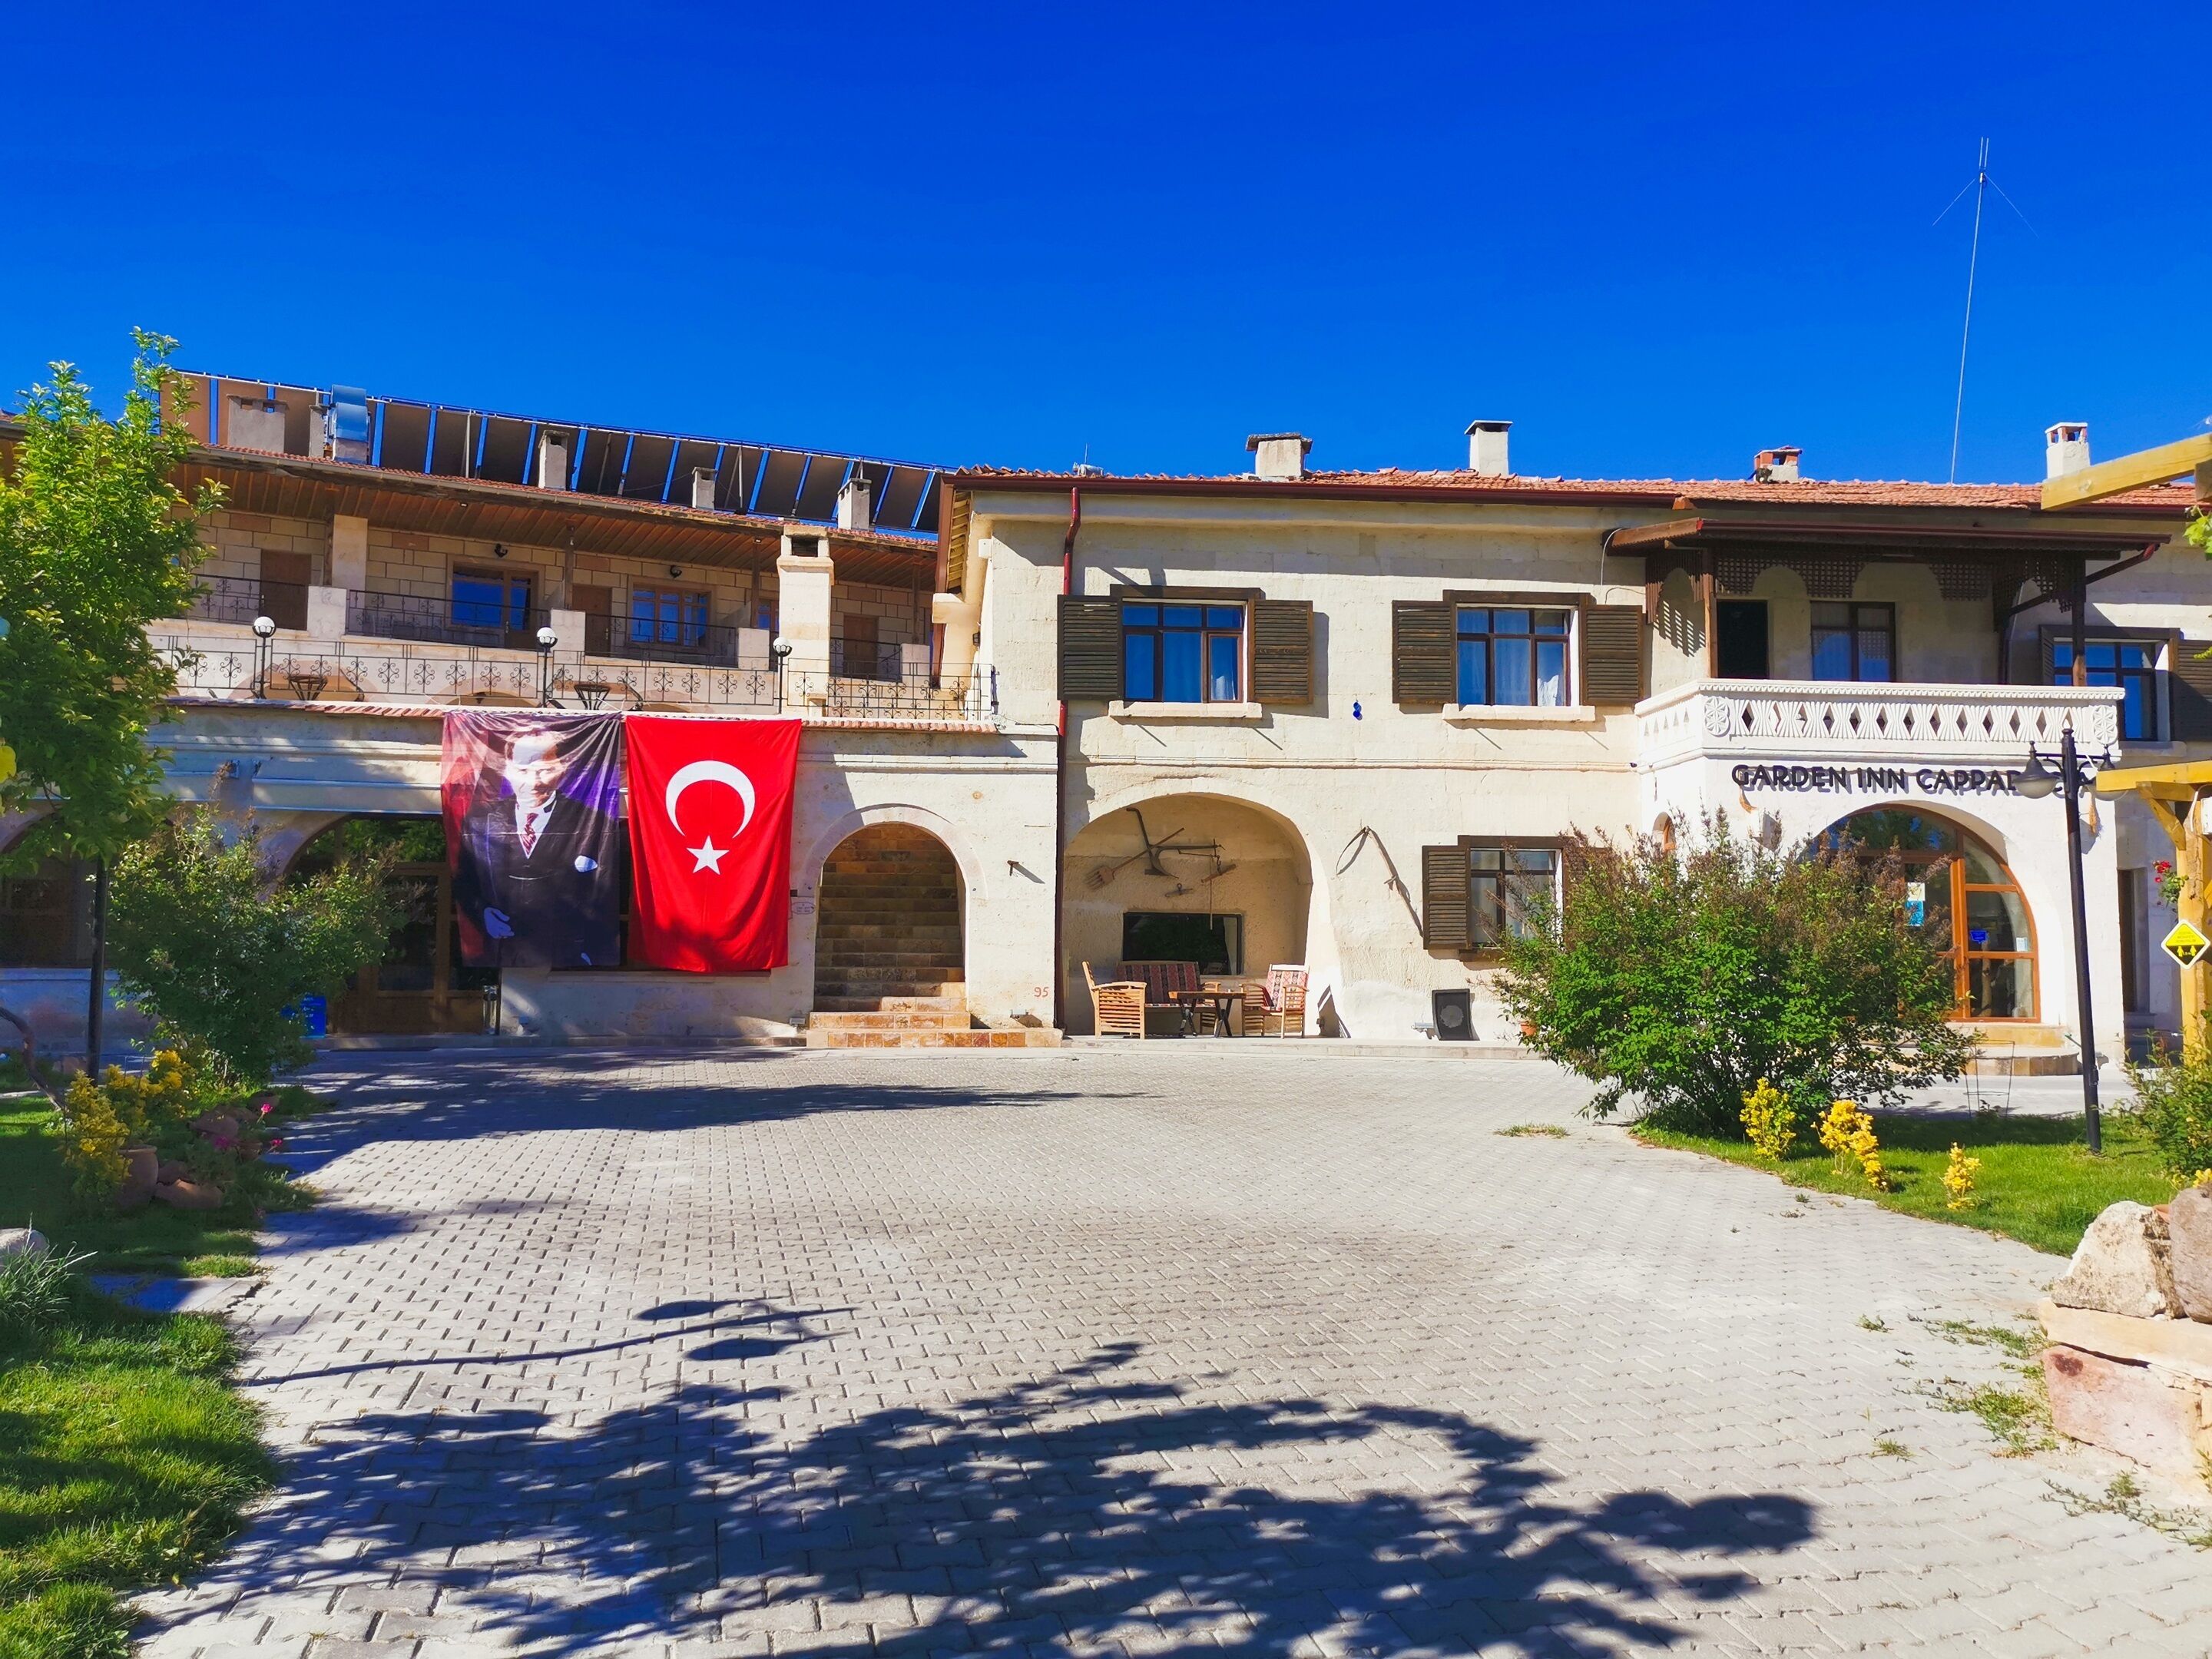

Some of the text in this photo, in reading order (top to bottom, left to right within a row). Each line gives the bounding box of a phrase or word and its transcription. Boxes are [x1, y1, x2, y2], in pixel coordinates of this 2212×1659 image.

[1732, 764, 1846, 787] GARDEN
[1857, 767, 1906, 789] INN
[1034, 986, 1049, 998] 95
